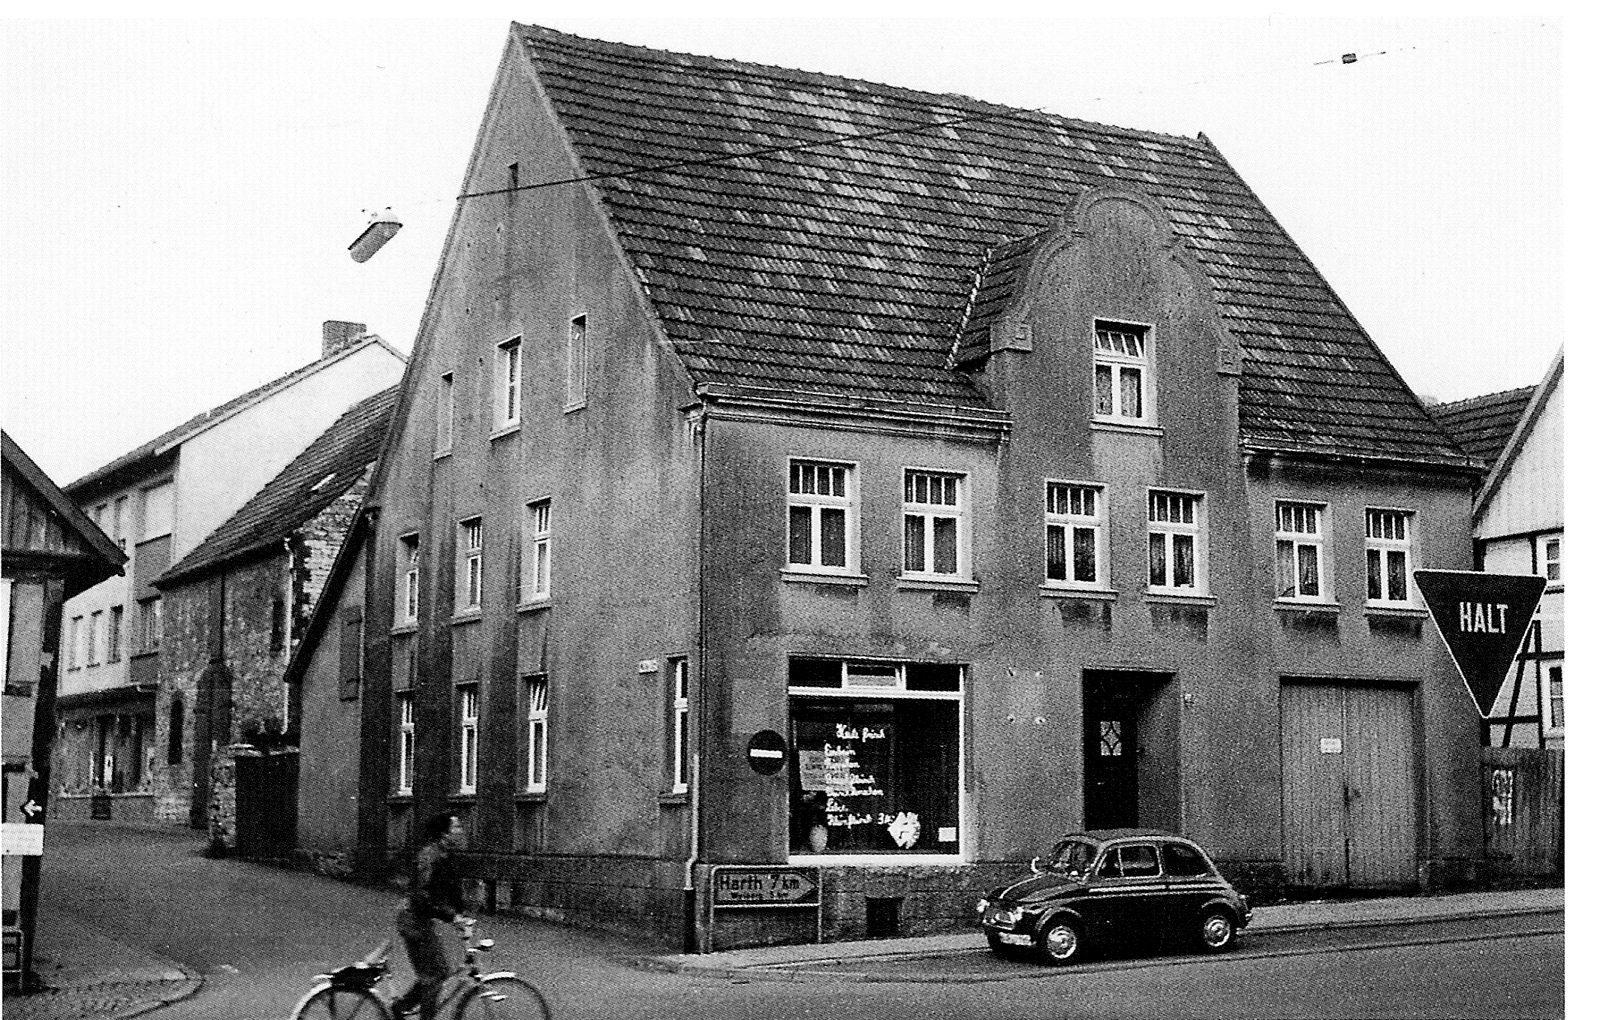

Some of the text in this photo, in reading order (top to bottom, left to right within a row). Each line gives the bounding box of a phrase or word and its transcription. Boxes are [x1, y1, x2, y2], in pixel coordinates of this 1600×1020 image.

[1459, 601, 1509, 634] HALT
[720, 874, 800, 890] Harth 7 km
